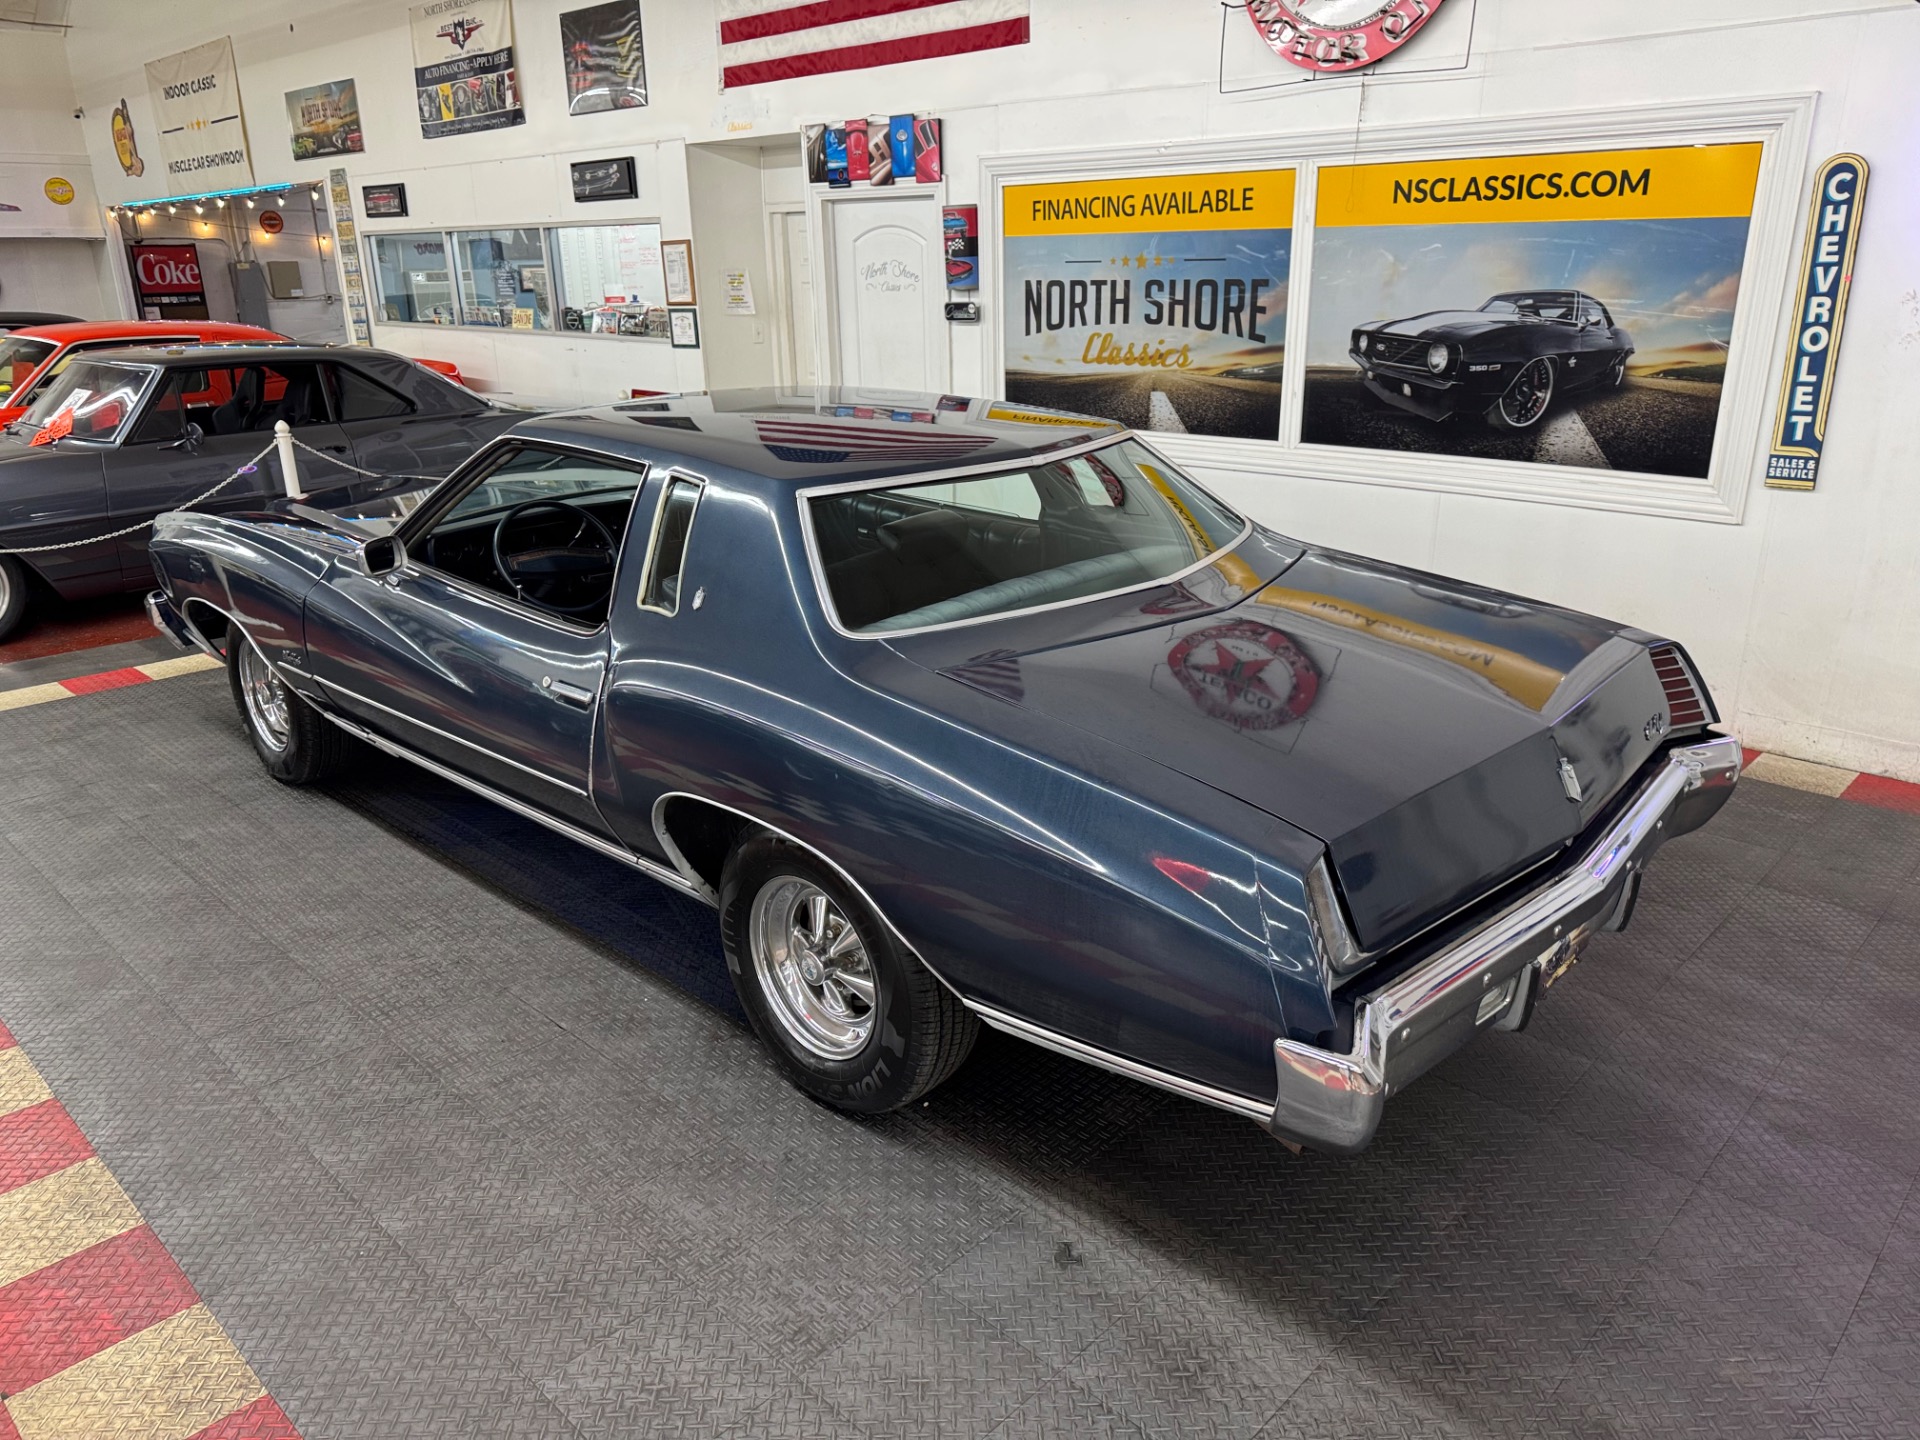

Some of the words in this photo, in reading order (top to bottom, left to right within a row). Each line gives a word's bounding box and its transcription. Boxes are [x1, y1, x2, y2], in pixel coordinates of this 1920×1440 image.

[163, 82, 191, 100] INDOOR
[190, 74, 216, 94] CLASSIC
[168, 158, 192, 174] MUSCLE
[192, 156, 206, 170] CAR
[205, 149, 245, 168] SHOWROOM
[1393, 168, 1651, 204] NSCLASSICS.COM
[1032, 195, 1135, 221] FINANCING
[1140, 187, 1254, 216] AVAILABLE
[136, 254, 201, 285] Coke
[1024, 279, 1131, 337] NORTH
[1144, 278, 1270, 344] SHORE
[1789, 172, 1854, 441] CHEVROLET
[1082, 332, 1194, 369] Classics
[1768, 467, 1815, 479] SERVICE
[1770, 457, 1805, 469] SALES
[1806, 460, 1816, 469] &
[848, 1057, 892, 1100] LION
